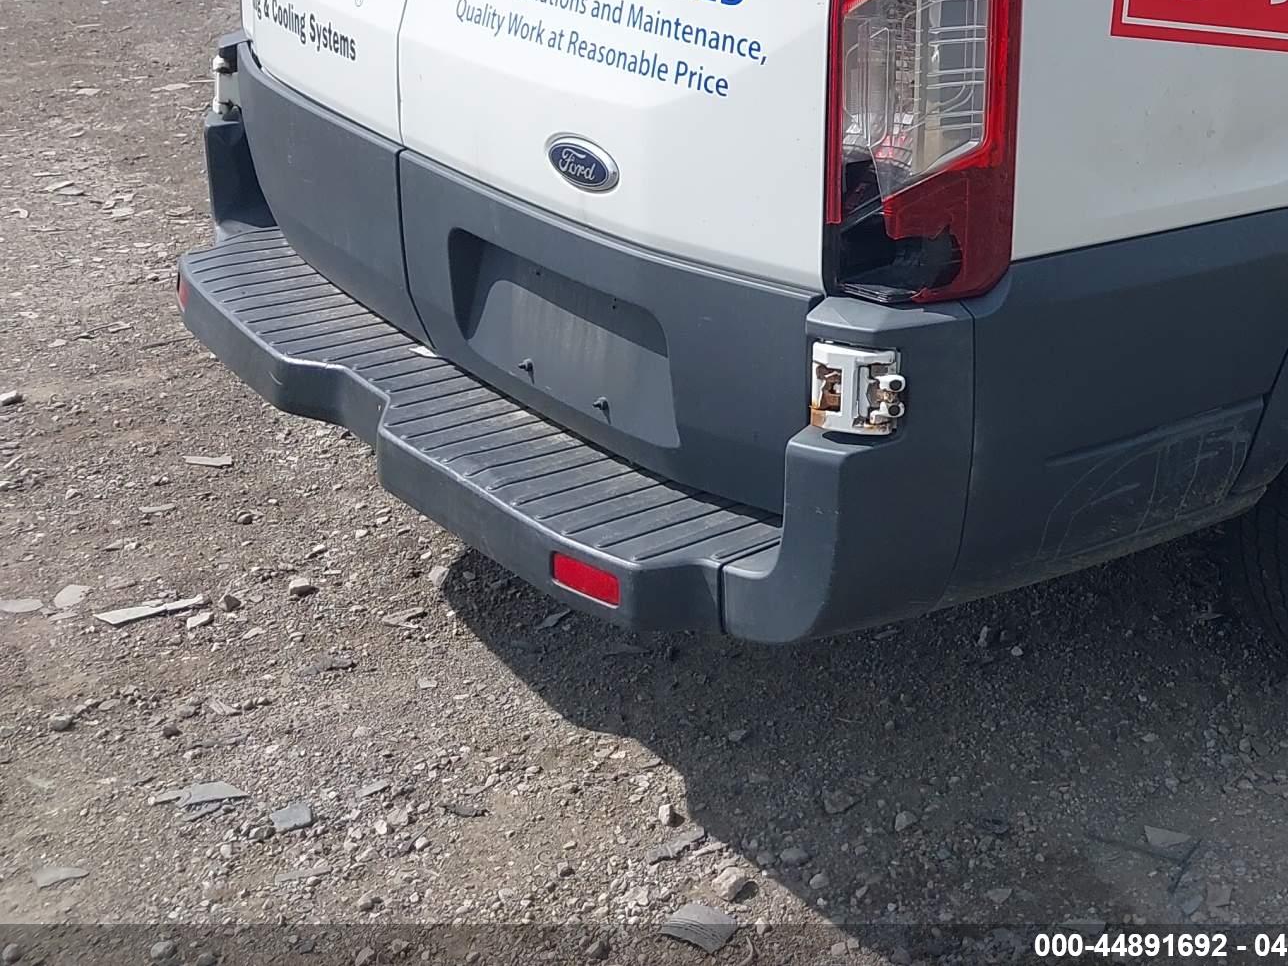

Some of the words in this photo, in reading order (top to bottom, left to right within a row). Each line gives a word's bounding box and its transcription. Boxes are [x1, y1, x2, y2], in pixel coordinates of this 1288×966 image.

[309, 13, 356, 61] Systems
[507, 11, 544, 46] Work
[547, 28, 565, 52] at
[566, 30, 669, 82] Reasonable
[674, 60, 729, 97] Price
[590, 0, 624, 25] and
[626, 3, 768, 66] Maintenance,
[559, 147, 596, 180] Ford
